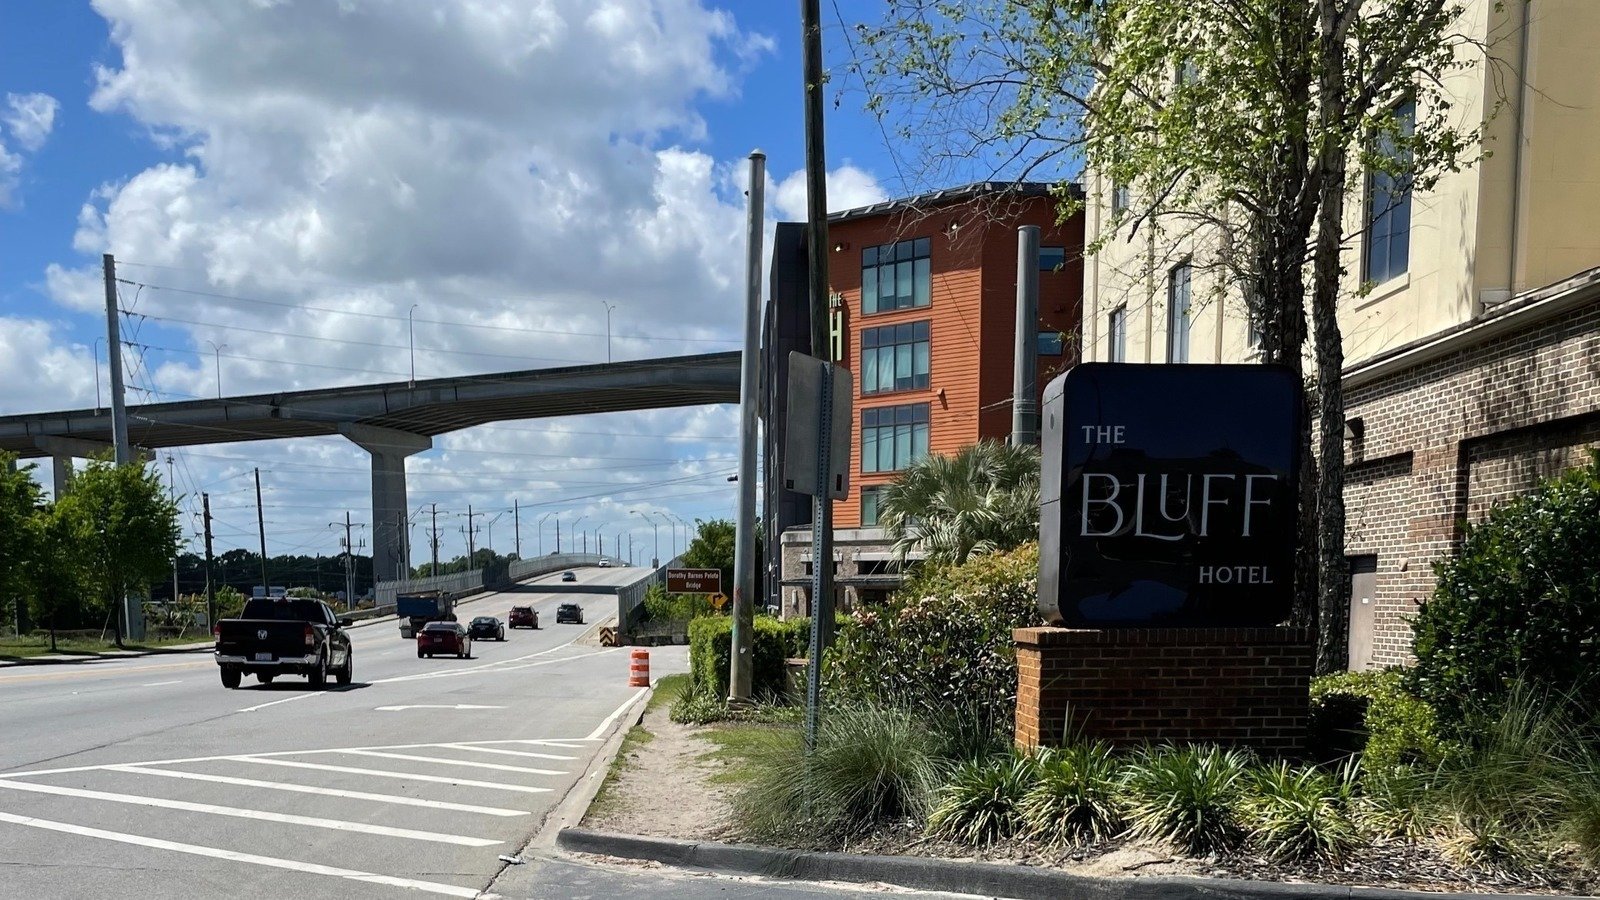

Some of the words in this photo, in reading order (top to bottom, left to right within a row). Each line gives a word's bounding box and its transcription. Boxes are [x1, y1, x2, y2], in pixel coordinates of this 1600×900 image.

[1081, 425, 1126, 444] THE
[1079, 473, 1278, 541] BLUFF
[1199, 566, 1274, 584] HOTEL
[685, 581, 702, 590] Bridge
